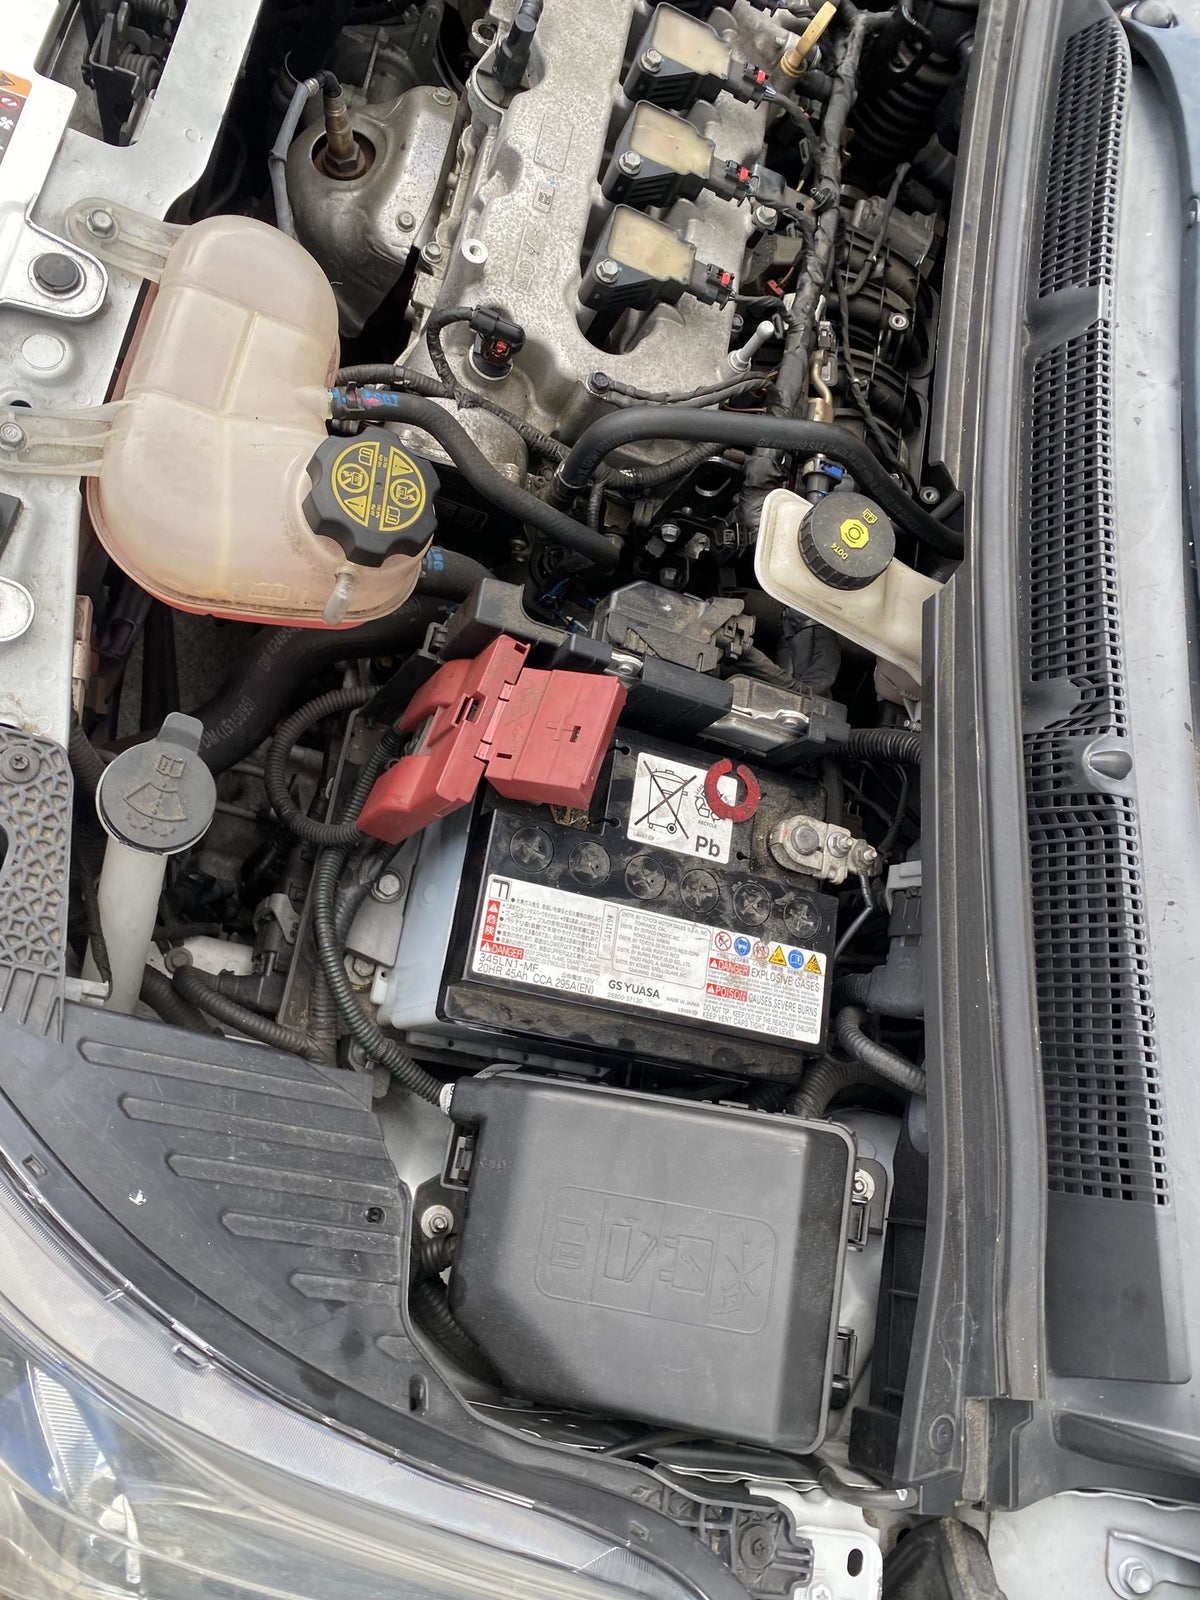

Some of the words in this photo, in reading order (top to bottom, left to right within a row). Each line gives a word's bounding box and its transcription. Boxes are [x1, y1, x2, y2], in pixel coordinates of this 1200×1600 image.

[831, 543, 848, 560] DOT4
[698, 820, 717, 828] RECYCLE
[694, 835, 722, 857] Pb
[484, 914, 497, 936] 危険
[492, 945, 523, 959] DANGER
[479, 953, 539, 973] 345LN1-MF
[477, 963, 503, 975] 20HR
[505, 968, 528, 981] 45Ah
[532, 974, 553, 986] CCA
[555, 978, 595, 994] 295A(EN)
[718, 961, 749, 976] DANGER
[751, 969, 793, 986] EXPLOSIVE
[794, 978, 821, 992] GASES
[608, 980, 623, 991] GS
[622, 983, 661, 999] YUASA
[714, 986, 747, 1001] POISON
[773, 999, 796, 1012] SEVERE
[797, 1005, 818, 1017] BURNS
[702, 1011, 718, 1020] KEEP
[718, 1014, 732, 1023] VENT
[732, 1017, 749, 1027] CAPS
[749, 1021, 765, 1031] TIGHT
[766, 1025, 779, 1034] AND
[772, 1019, 788, 1028] REACH
[795, 1025, 818, 1035] CHILDREN
